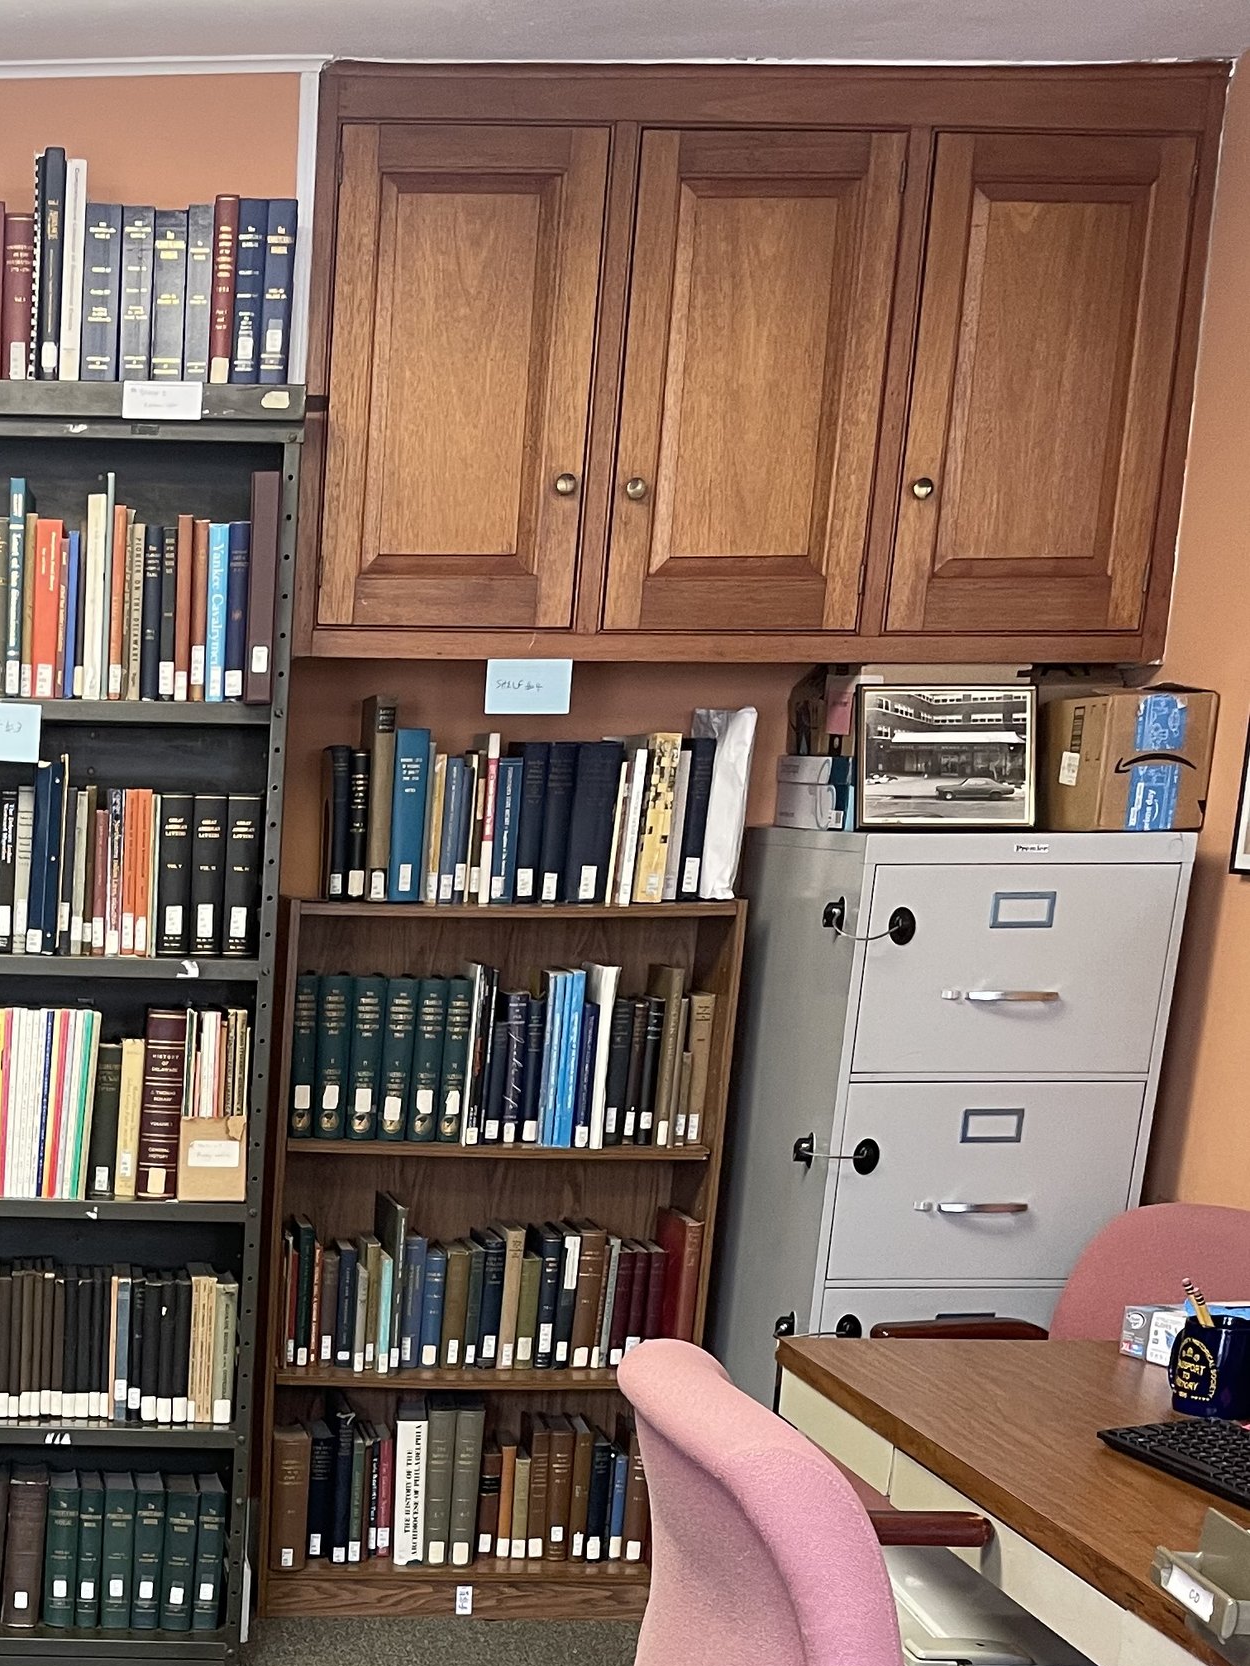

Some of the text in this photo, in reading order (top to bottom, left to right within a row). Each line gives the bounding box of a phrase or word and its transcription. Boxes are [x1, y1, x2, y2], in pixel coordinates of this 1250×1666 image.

[211, 543, 225, 590] Yankee
[134, 579, 141, 591] ON
[413, 1424, 422, 1487] PHILADELPHIA
[406, 1470, 412, 1479] OF
